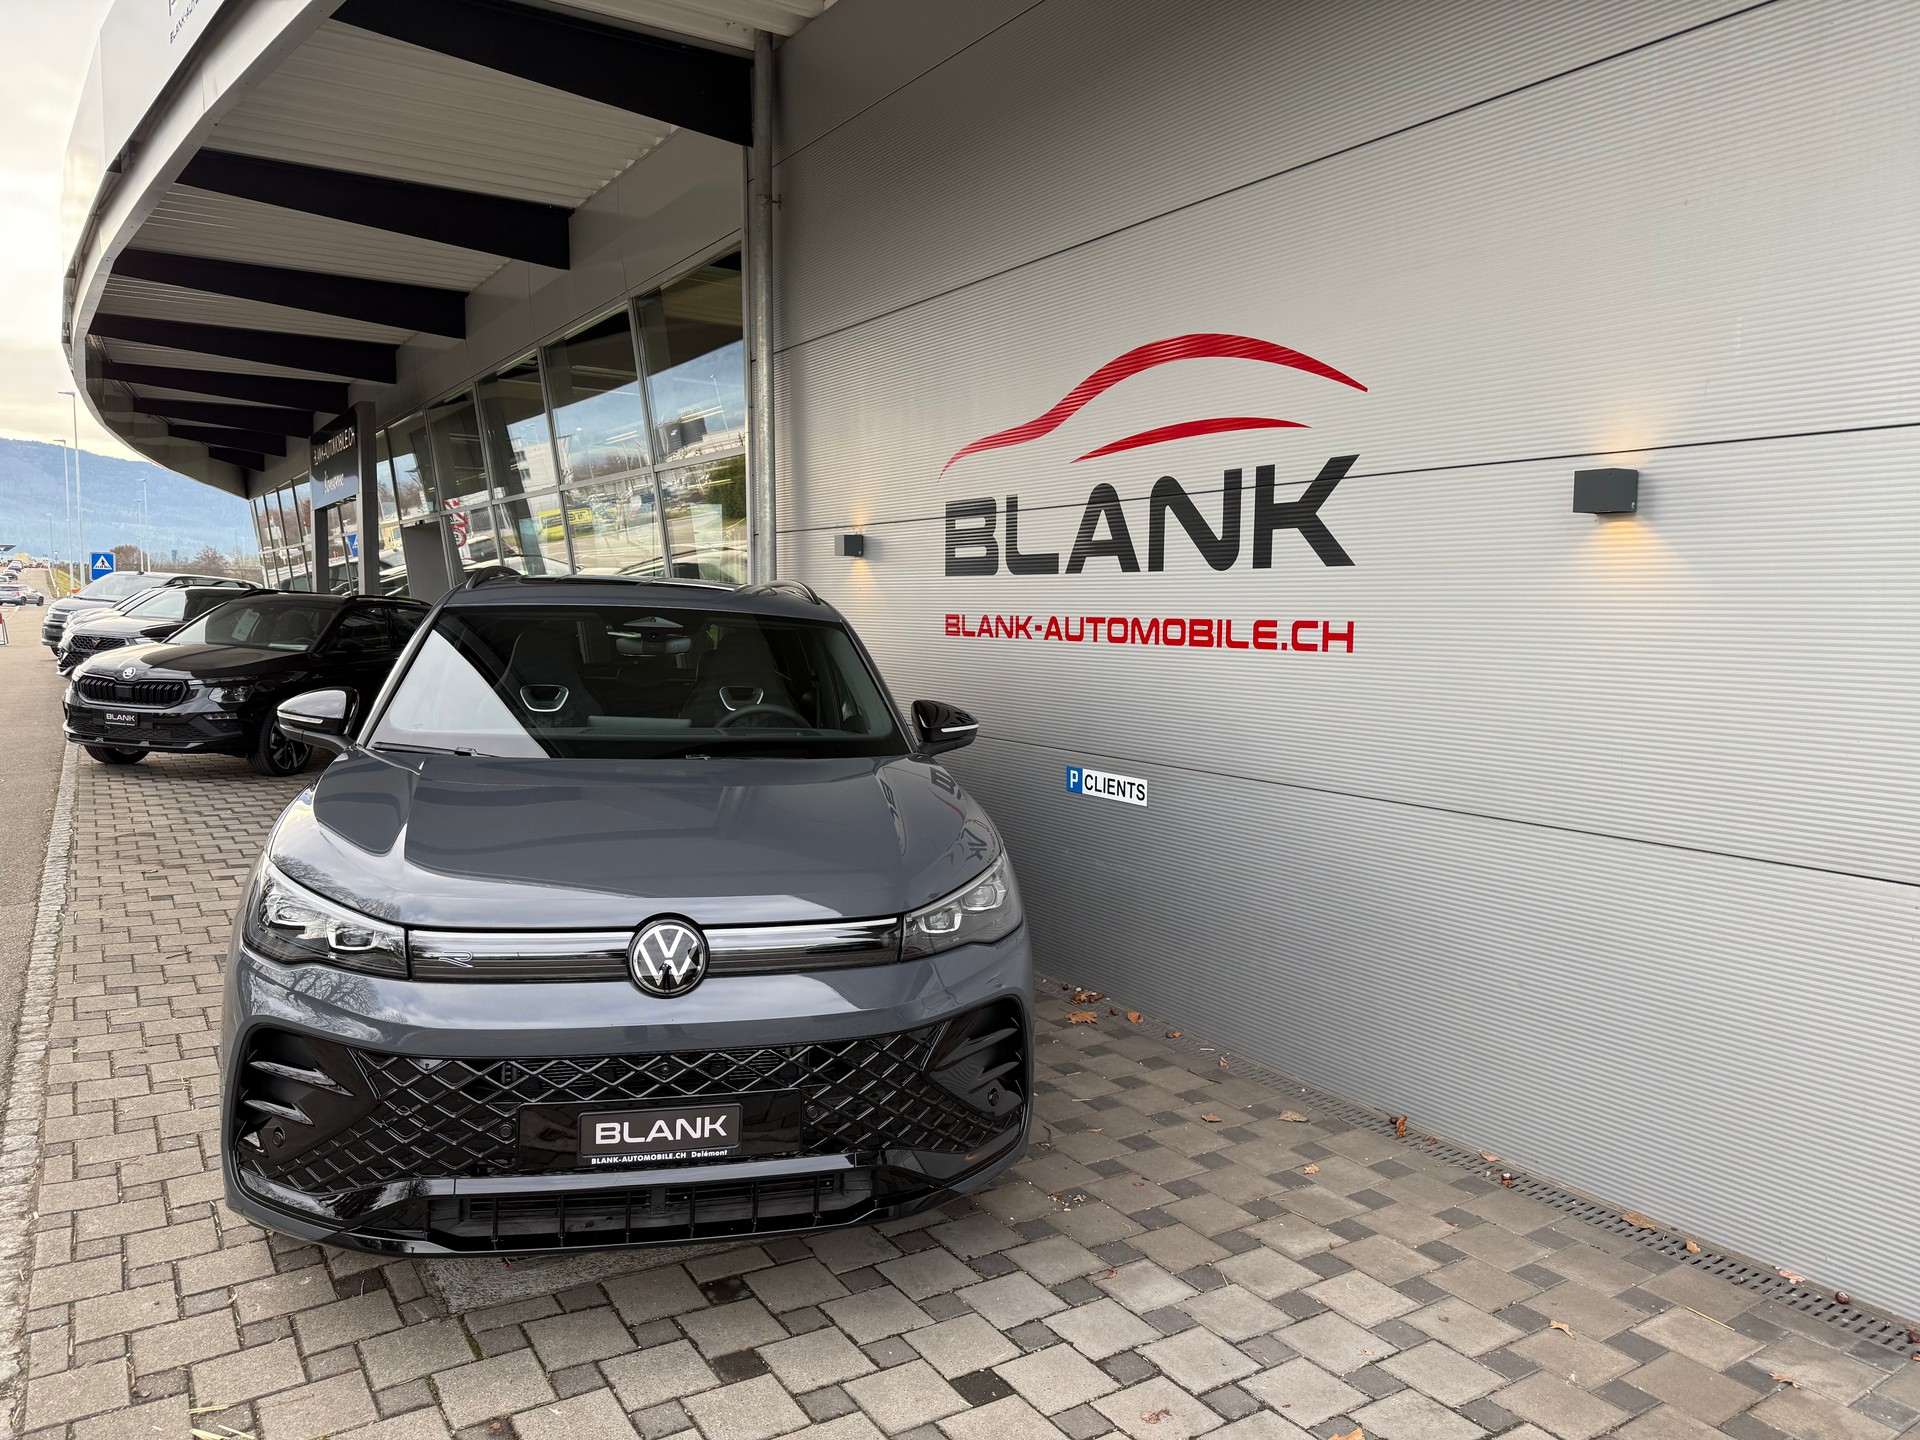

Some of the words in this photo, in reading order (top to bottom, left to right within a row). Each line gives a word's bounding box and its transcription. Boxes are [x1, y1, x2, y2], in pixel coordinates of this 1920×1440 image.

[945, 454, 1360, 576] BLANK
[945, 614, 1355, 653] BLANK-AUTOMOBILE.CH
[106, 713, 136, 722] BLANK
[1070, 769, 1079, 789] P
[1084, 774, 1146, 801] CLIENTS
[595, 1114, 728, 1145] BLANK
[591, 1152, 687, 1165] BLANK-AUTOMOBILE.CH
[691, 1149, 728, 1159] Delémont
